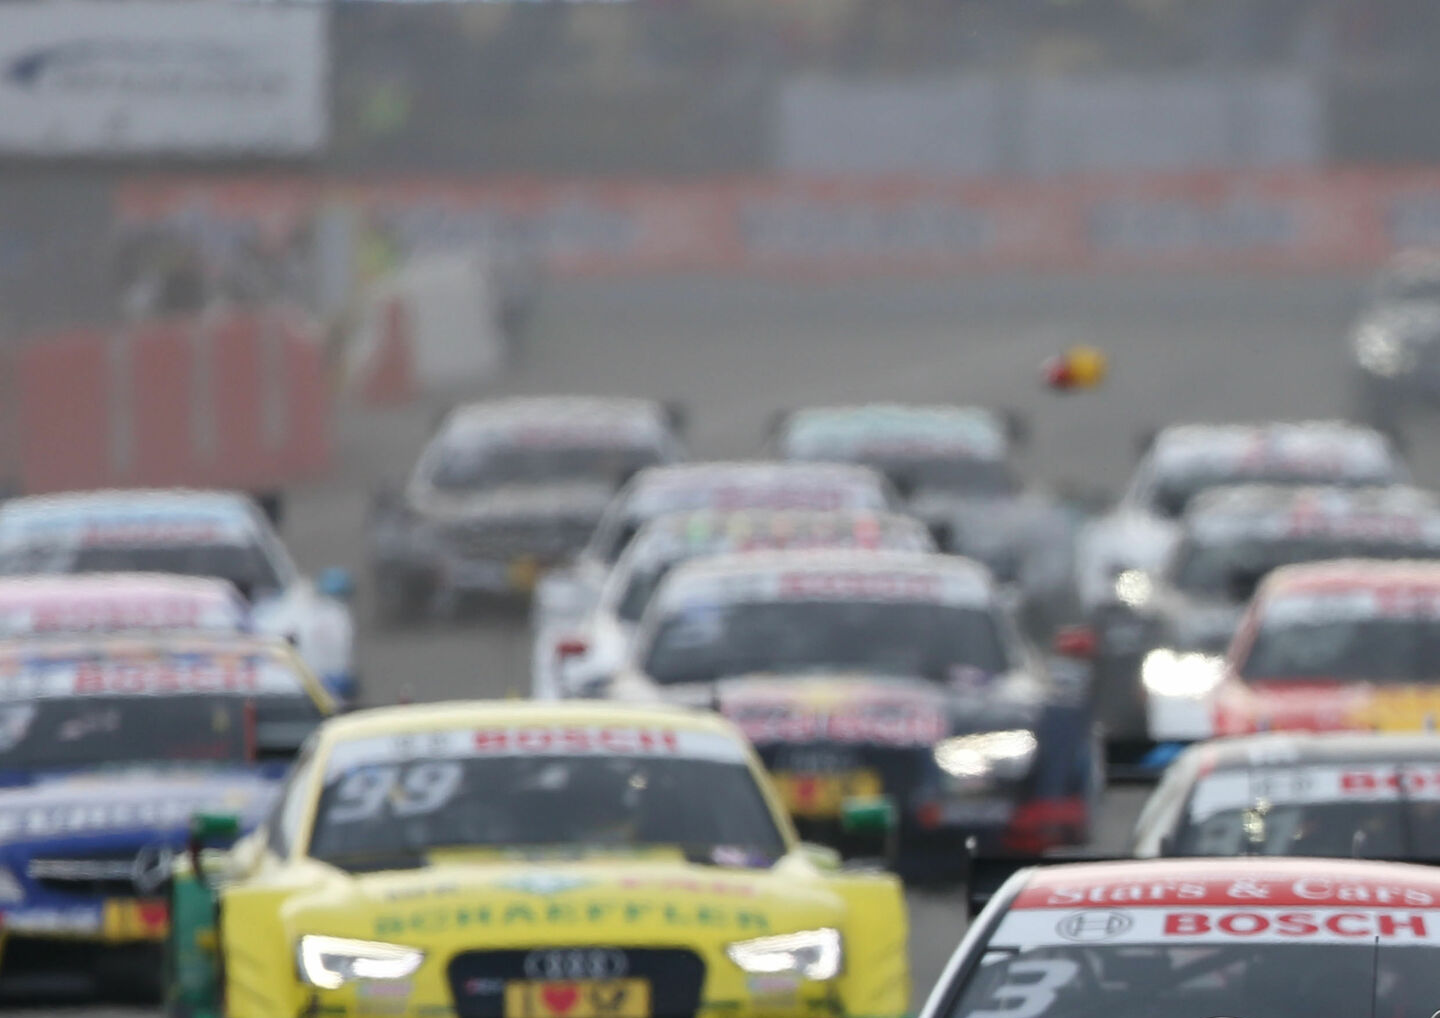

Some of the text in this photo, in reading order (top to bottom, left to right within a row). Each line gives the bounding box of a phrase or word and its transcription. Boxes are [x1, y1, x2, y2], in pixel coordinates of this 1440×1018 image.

[472, 728, 678, 752] BOSCH
[326, 760, 466, 818] 99
[1163, 911, 1430, 938] BOSCH
